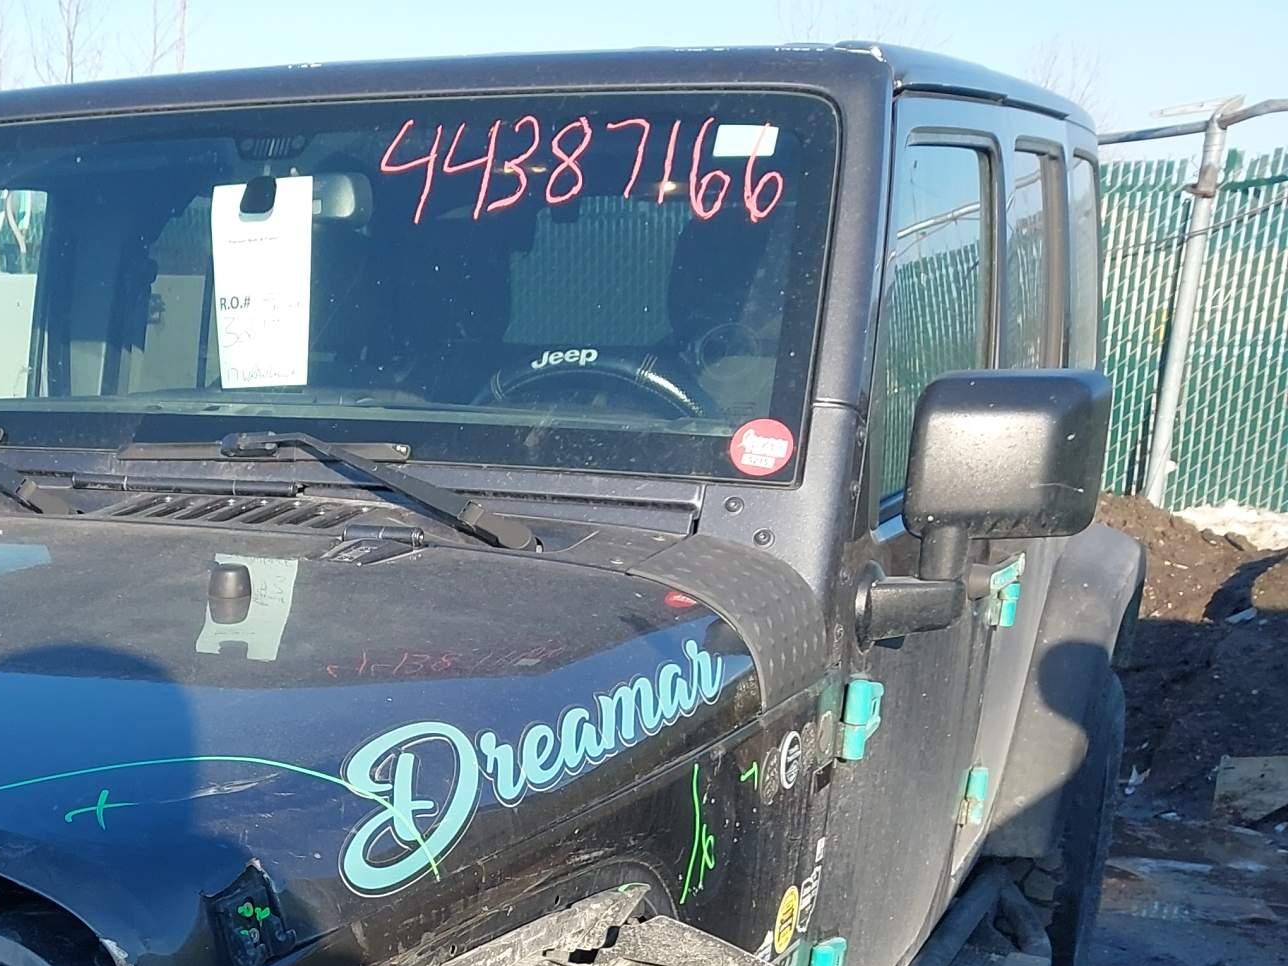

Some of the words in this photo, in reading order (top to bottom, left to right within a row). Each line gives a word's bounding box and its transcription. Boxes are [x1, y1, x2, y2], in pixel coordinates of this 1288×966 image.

[380, 115, 784, 223] 44387166
[220, 296, 251, 311] R.O.#
[531, 348, 598, 369] Jeep
[339, 639, 724, 897] Dreamar
